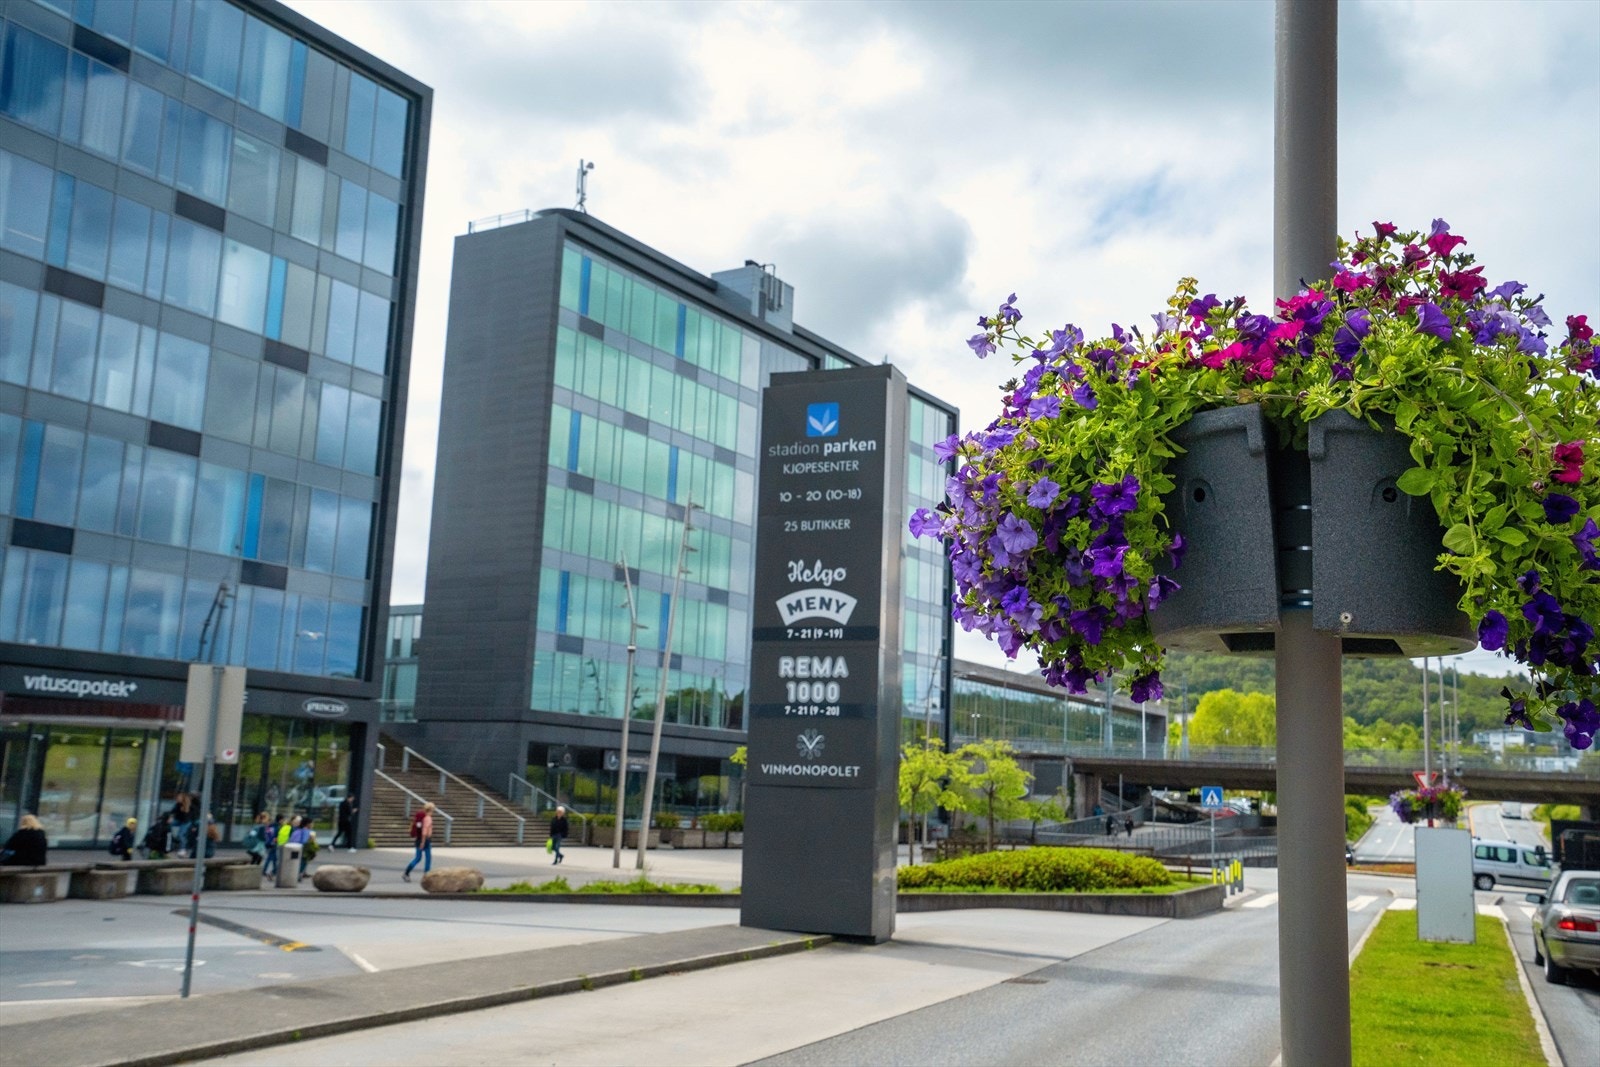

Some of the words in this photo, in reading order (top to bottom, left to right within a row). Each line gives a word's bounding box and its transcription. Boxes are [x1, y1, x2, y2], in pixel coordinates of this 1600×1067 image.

[768, 442, 819, 457] stadion
[823, 438, 877, 456] parken
[783, 460, 859, 474] KJØPESENTER
[780, 491, 792, 502] 10
[806, 490, 821, 501] 20
[826, 488, 862, 501] (10-18)
[784, 521, 798, 532] 25
[801, 519, 851, 531] BUTIKKER
[786, 596, 847, 616] MENY
[779, 656, 849, 678] REMA
[786, 681, 840, 703] 1000
[761, 763, 860, 777] VINMONOPOLET
